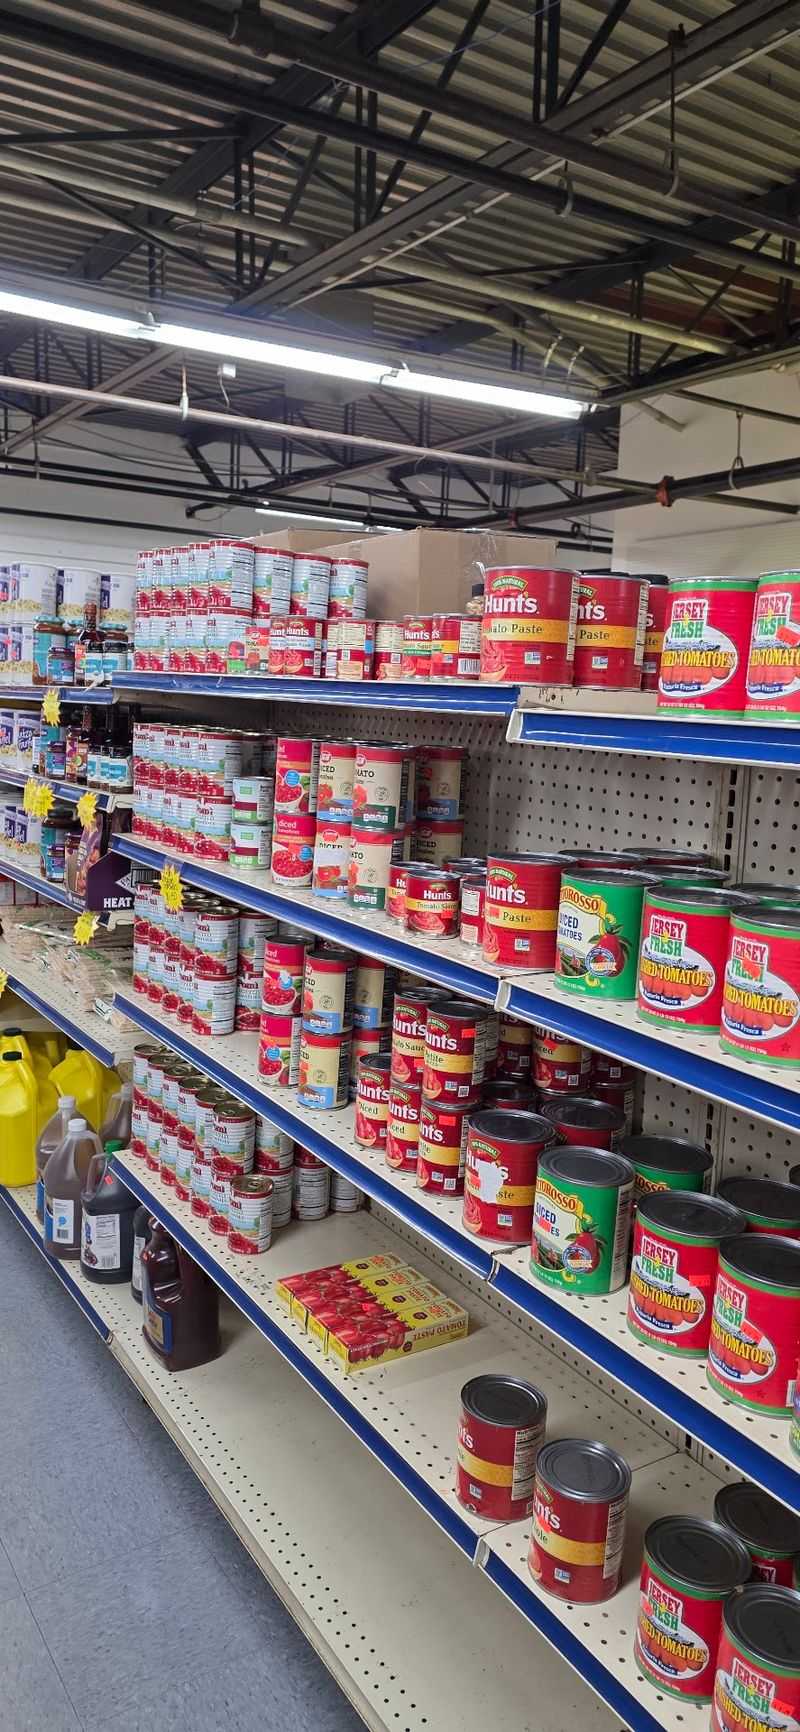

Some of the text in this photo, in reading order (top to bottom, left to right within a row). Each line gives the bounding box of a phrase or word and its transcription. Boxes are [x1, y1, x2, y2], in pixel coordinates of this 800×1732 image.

[484, 592, 538, 614] Hunt's
[577, 601, 606, 621] nt's
[511, 623, 543, 635] Paste
[579, 629, 610, 641] Paste
[279, 821, 297, 829] diced
[103, 897, 132, 908] HEAT
[423, 890, 452, 900] Hunt's
[503, 911, 531, 923] Paste
[652, 917, 684, 939] JERSEY
[650, 936, 682, 957] FRESH
[734, 940, 767, 963] JERSEY
[405, 1042, 425, 1052] Sauc
[425, 1031, 458, 1051] unt's
[389, 1103, 419, 1121] unt's
[392, 1125, 405, 1134] ced
[420, 1122, 445, 1142] nt's
[497, 1190, 515, 1200] ste
[643, 1238, 676, 1266] JERSEY
[641, 1256, 674, 1284] FRESH
[718, 1279, 745, 1308] JERSEY
[715, 1298, 743, 1327] FRESH
[534, 1499, 561, 1530] nt's
[651, 1580, 682, 1616] JERSEY
[652, 1601, 679, 1632] RESH
[734, 1660, 774, 1697] JERSEY
[732, 1679, 771, 1714] FRESH
